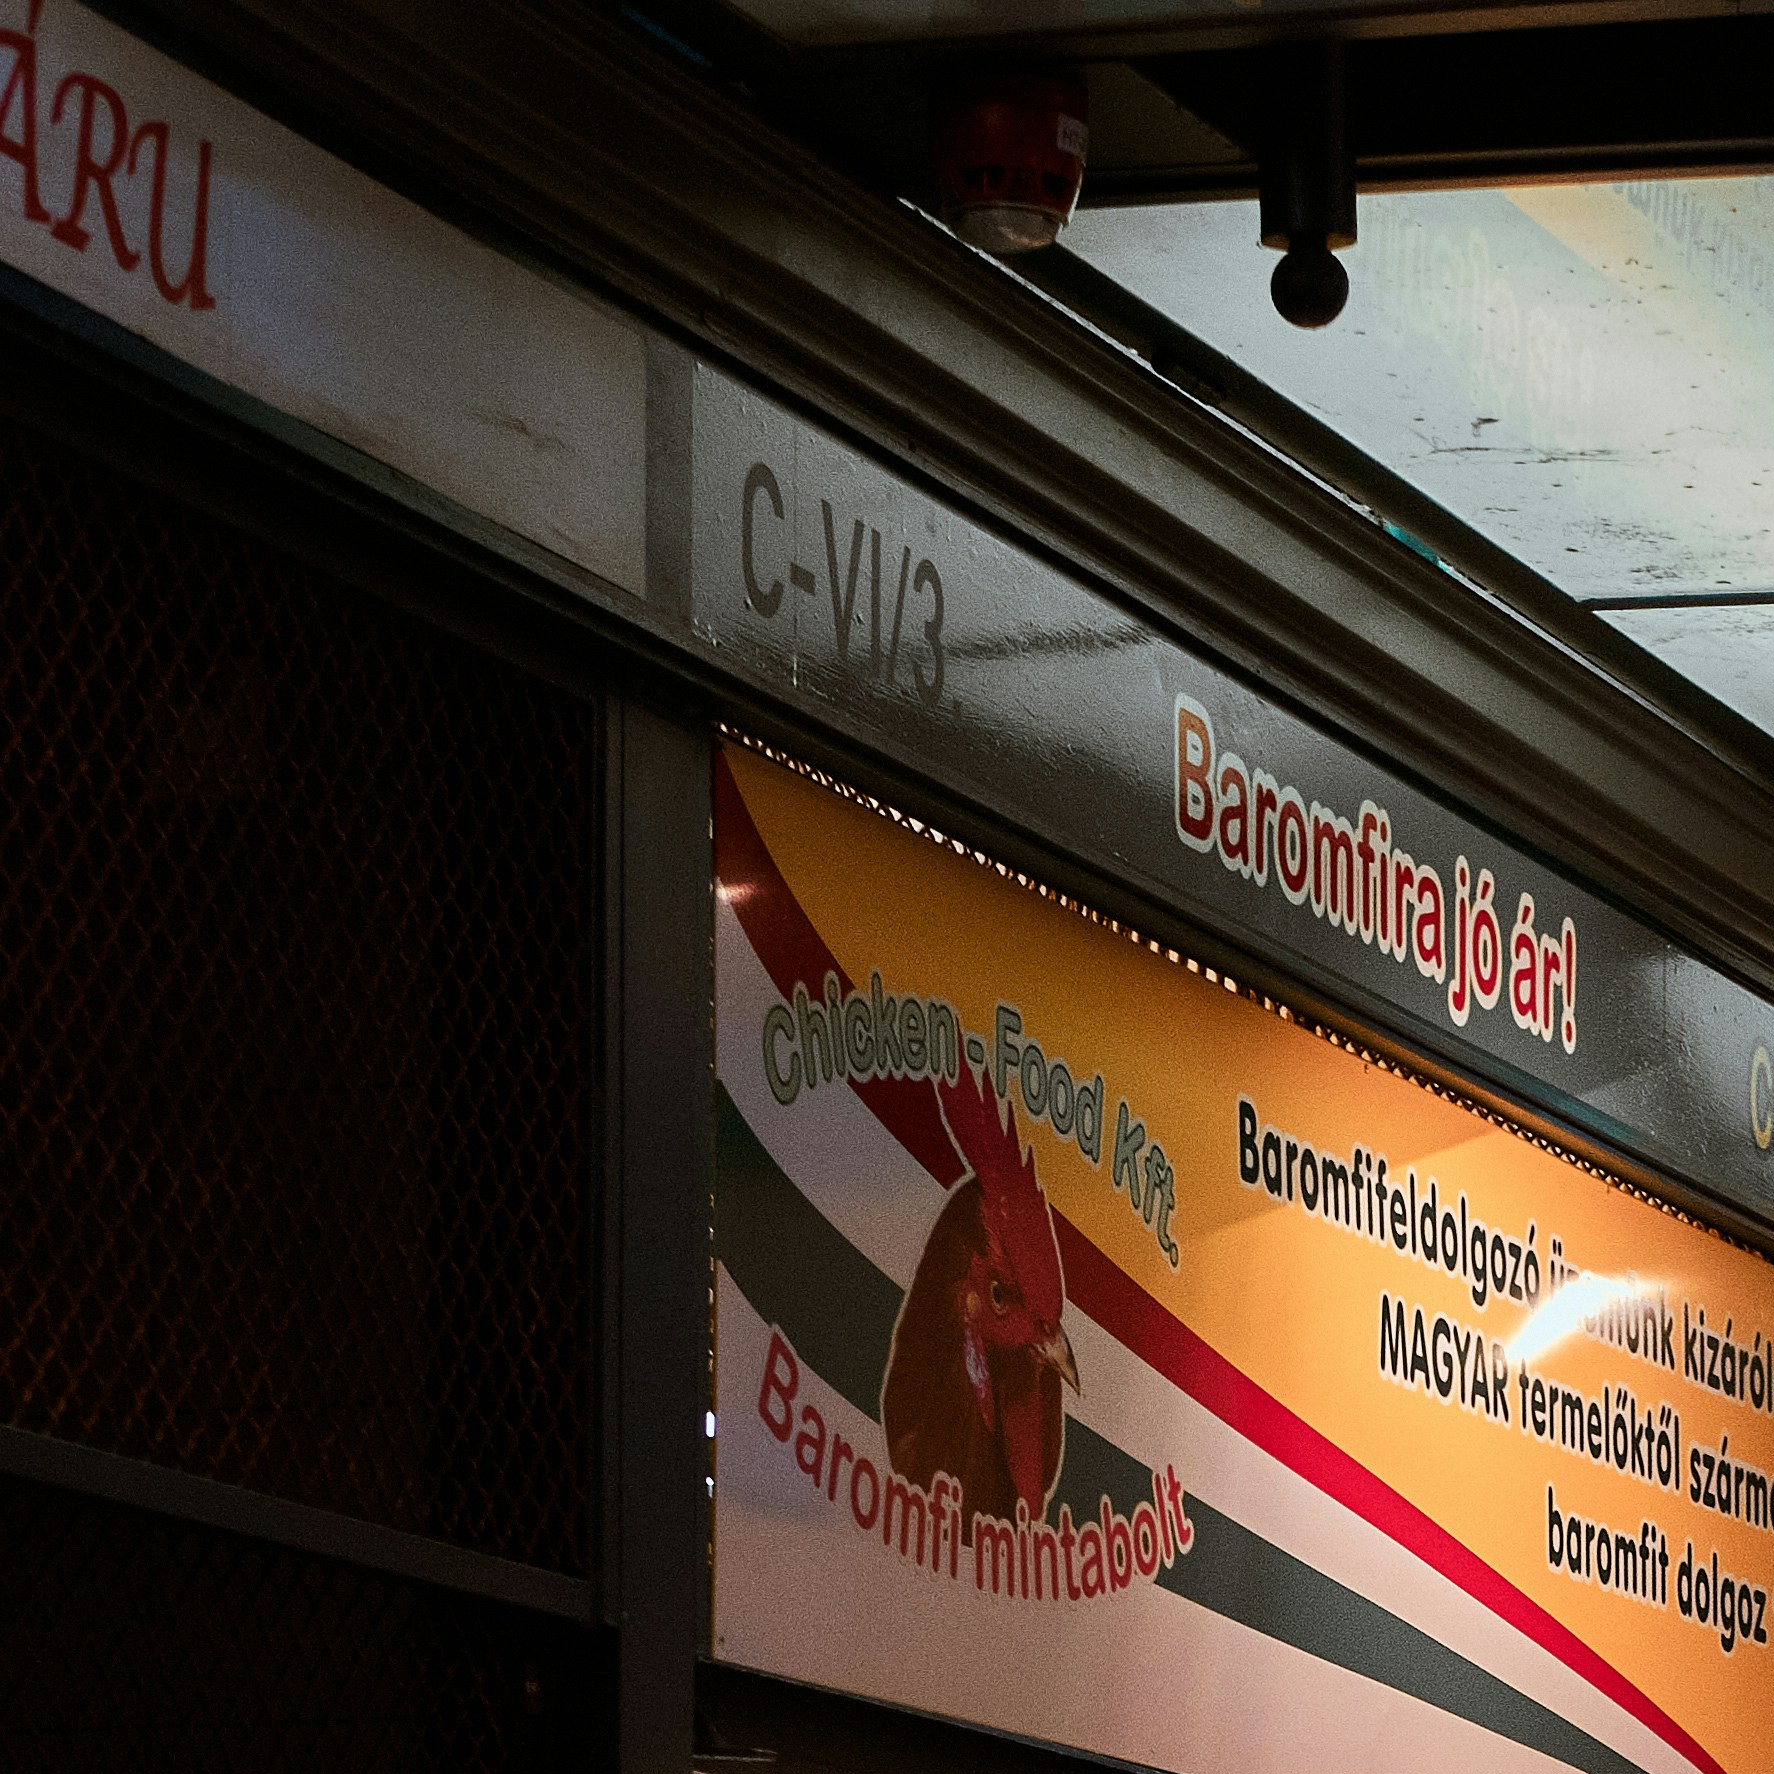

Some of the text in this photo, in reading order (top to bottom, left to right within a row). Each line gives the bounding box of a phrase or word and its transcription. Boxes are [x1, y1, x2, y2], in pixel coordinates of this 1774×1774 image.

[1175, 697, 1577, 1051] Baromfira jó ár!
[994, 1003, 1105, 1165] Food
[1111, 1100, 1180, 1268] Kft.
[1238, 1099, 1540, 1306] Baromfifeldolgozó
[758, 1331, 1192, 1601] Baromfi mintabolt
[1379, 1295, 1510, 1422] MAGYAR
[1519, 1358, 1680, 1491] termelőktől
[1547, 1487, 1668, 1604] baromfit
[1677, 1543, 1767, 1652] dolgoz
